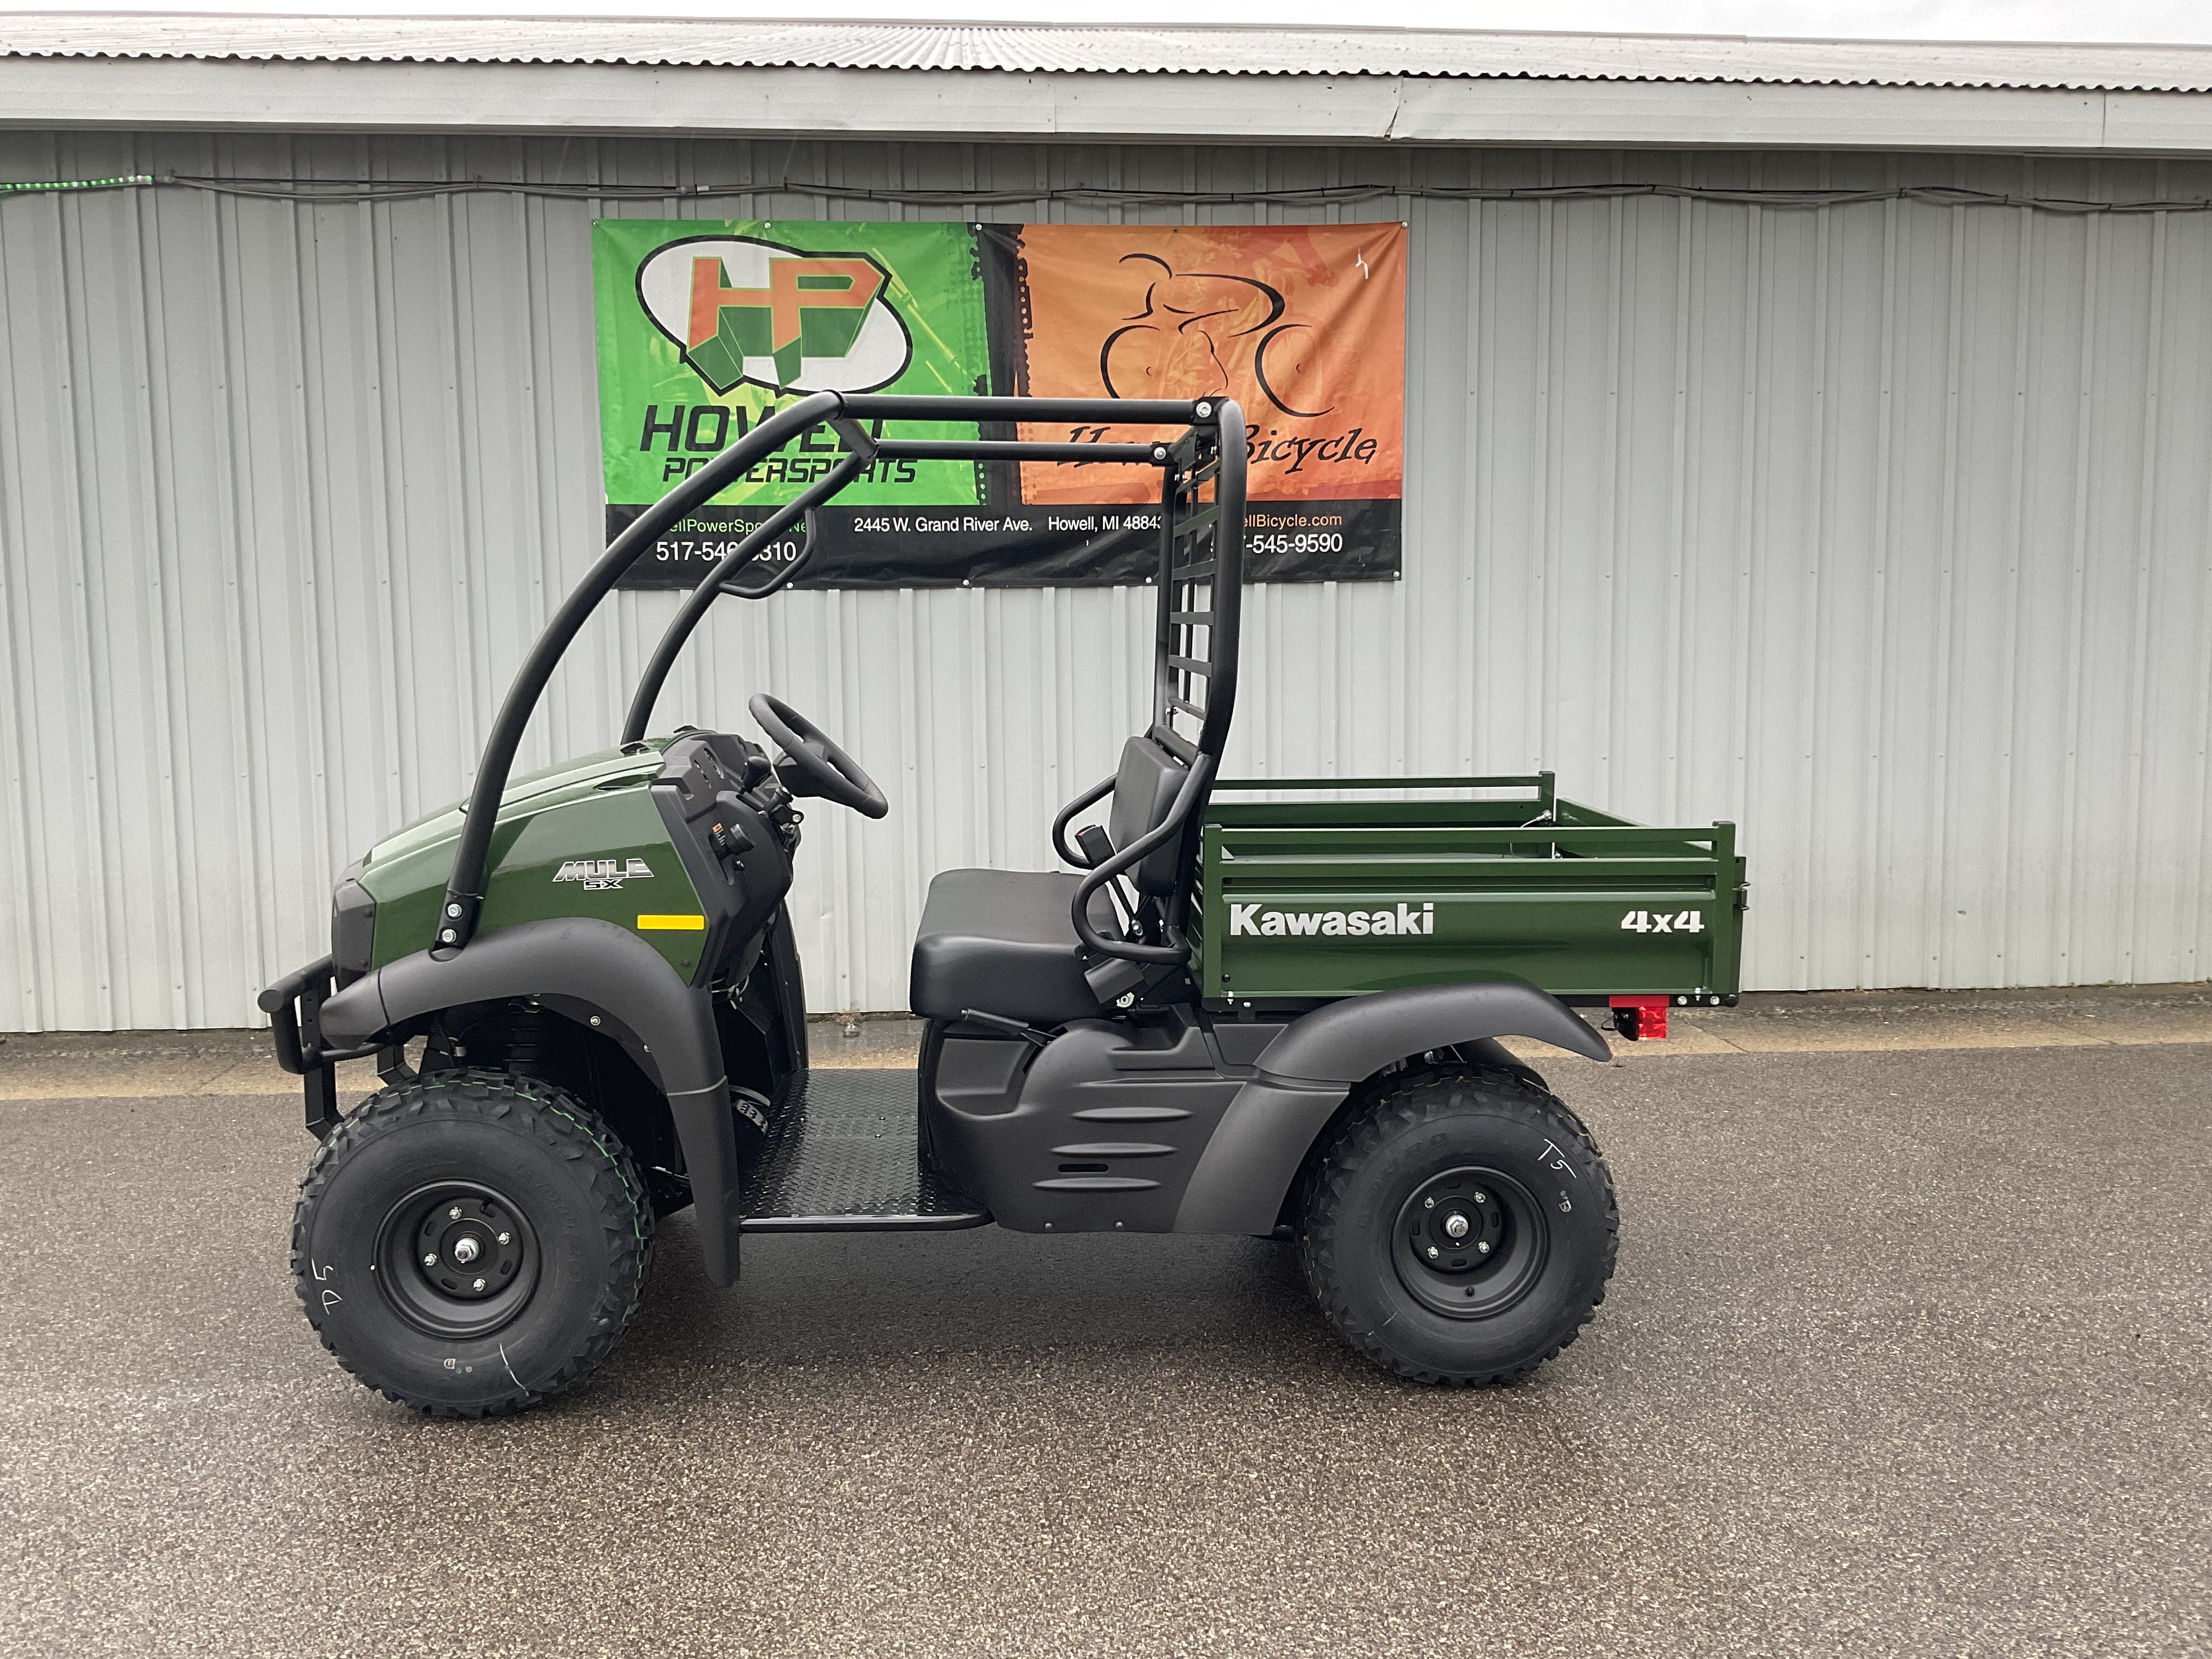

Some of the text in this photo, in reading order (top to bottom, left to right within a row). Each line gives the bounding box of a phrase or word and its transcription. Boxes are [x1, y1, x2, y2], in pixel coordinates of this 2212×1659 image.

[687, 257, 883, 353] HP
[640, 404, 884, 453] HOE
[662, 456, 918, 483] POERSPRTS
[854, 517, 890, 532] 2445
[893, 517, 911, 532] W.
[915, 517, 959, 532] Grand
[963, 517, 1000, 532] River
[1002, 517, 1032, 532] Ave.
[1048, 516, 1098, 533] Howell,
[1102, 516, 1119, 530] MI
[1244, 514, 1342, 531] llBicycle.com
[656, 541, 797, 561] 517-54310
[1243, 533, 1343, 554] -545-9590
[552, 857, 654, 882] MULE
[583, 878, 624, 890] SX
[1229, 902, 1434, 936] Kawasaki
[1621, 910, 1705, 934] 4x4
